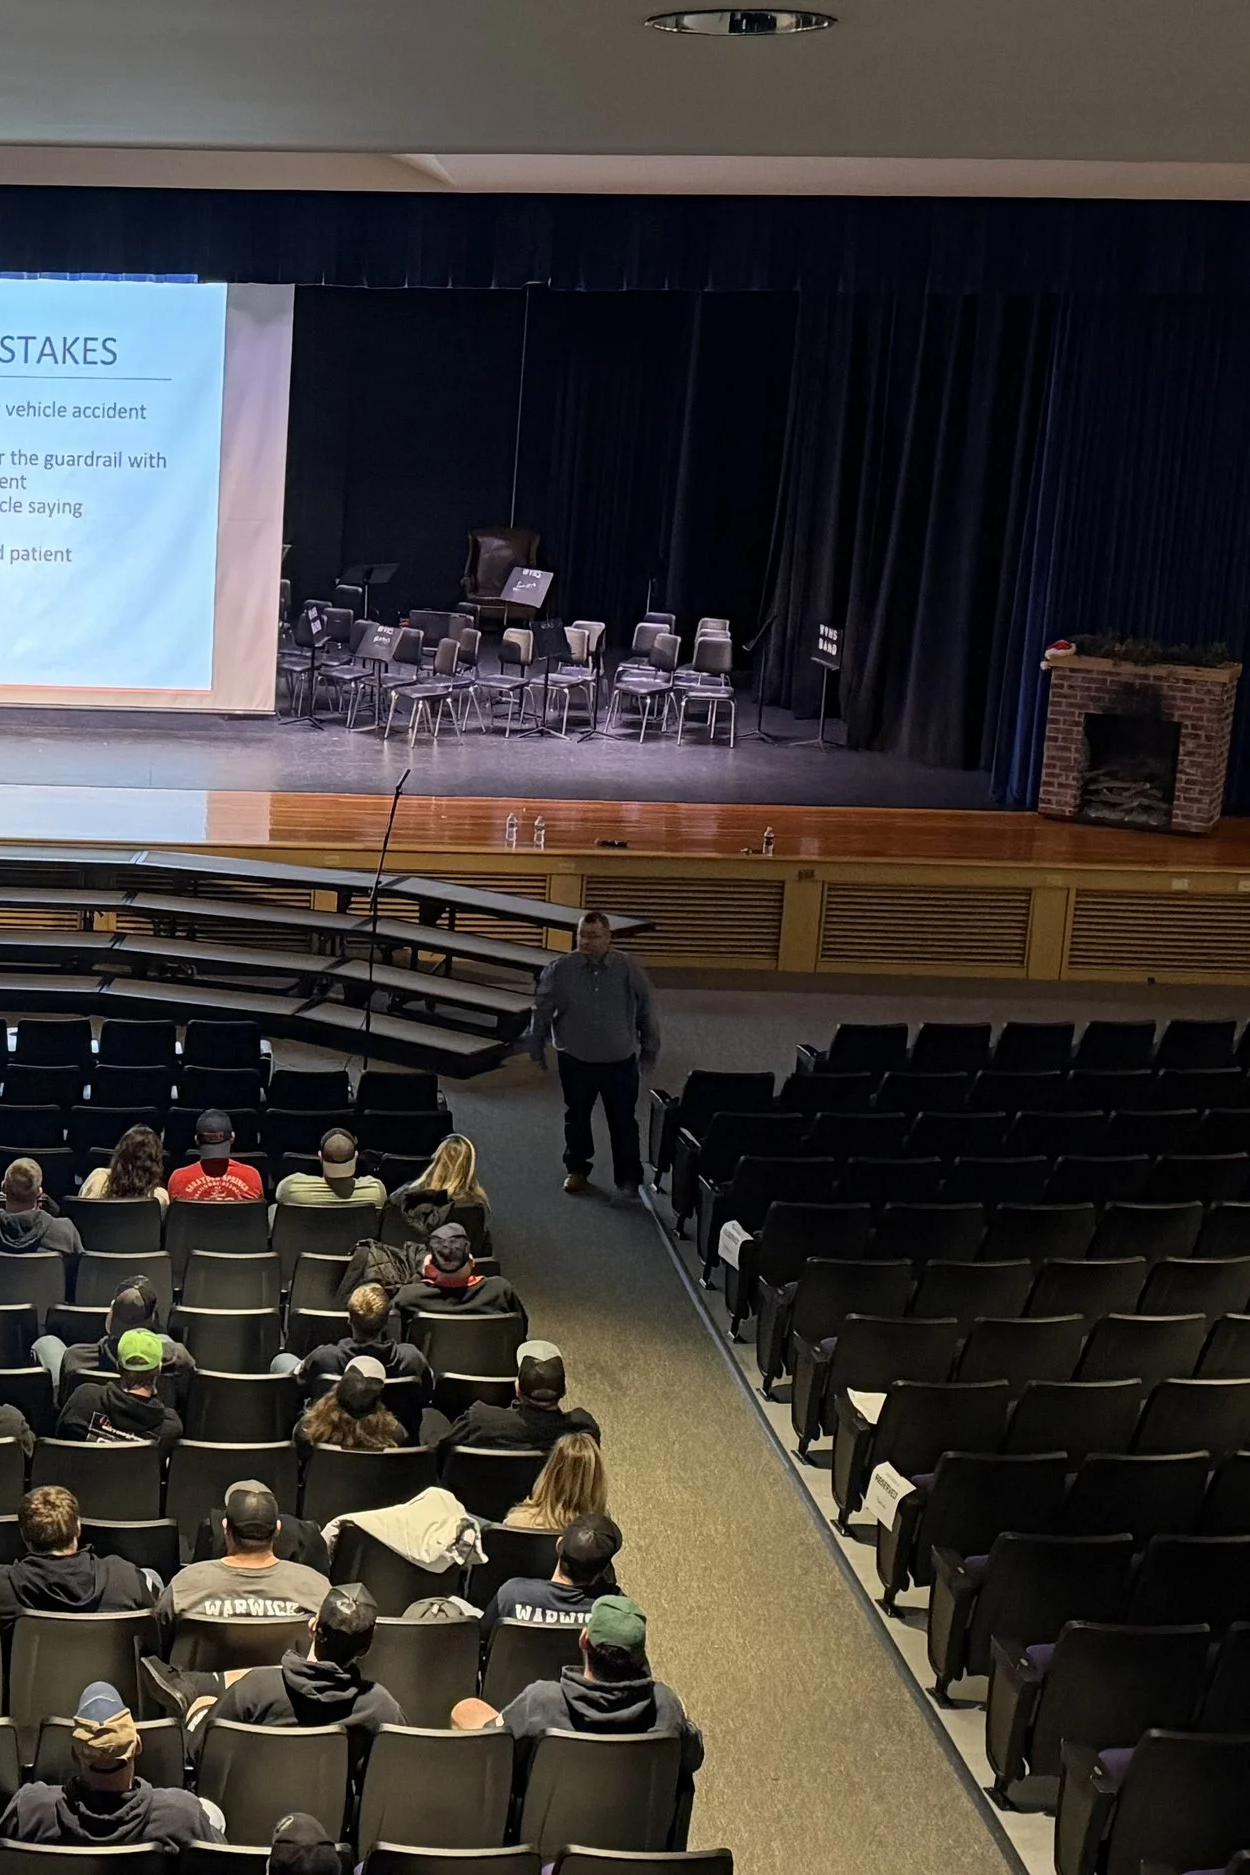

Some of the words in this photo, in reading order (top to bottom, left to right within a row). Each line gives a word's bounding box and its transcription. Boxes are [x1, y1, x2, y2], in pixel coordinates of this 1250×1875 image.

[5, 399, 68, 419] vehicle
[71, 401, 147, 421] accident
[9, 448, 40, 467] the
[43, 449, 123, 471] guardrail
[127, 451, 167, 470] with
[27, 498, 83, 520] saying
[9, 545, 73, 566] patient
[204, 1598, 300, 1618] WARWICK
